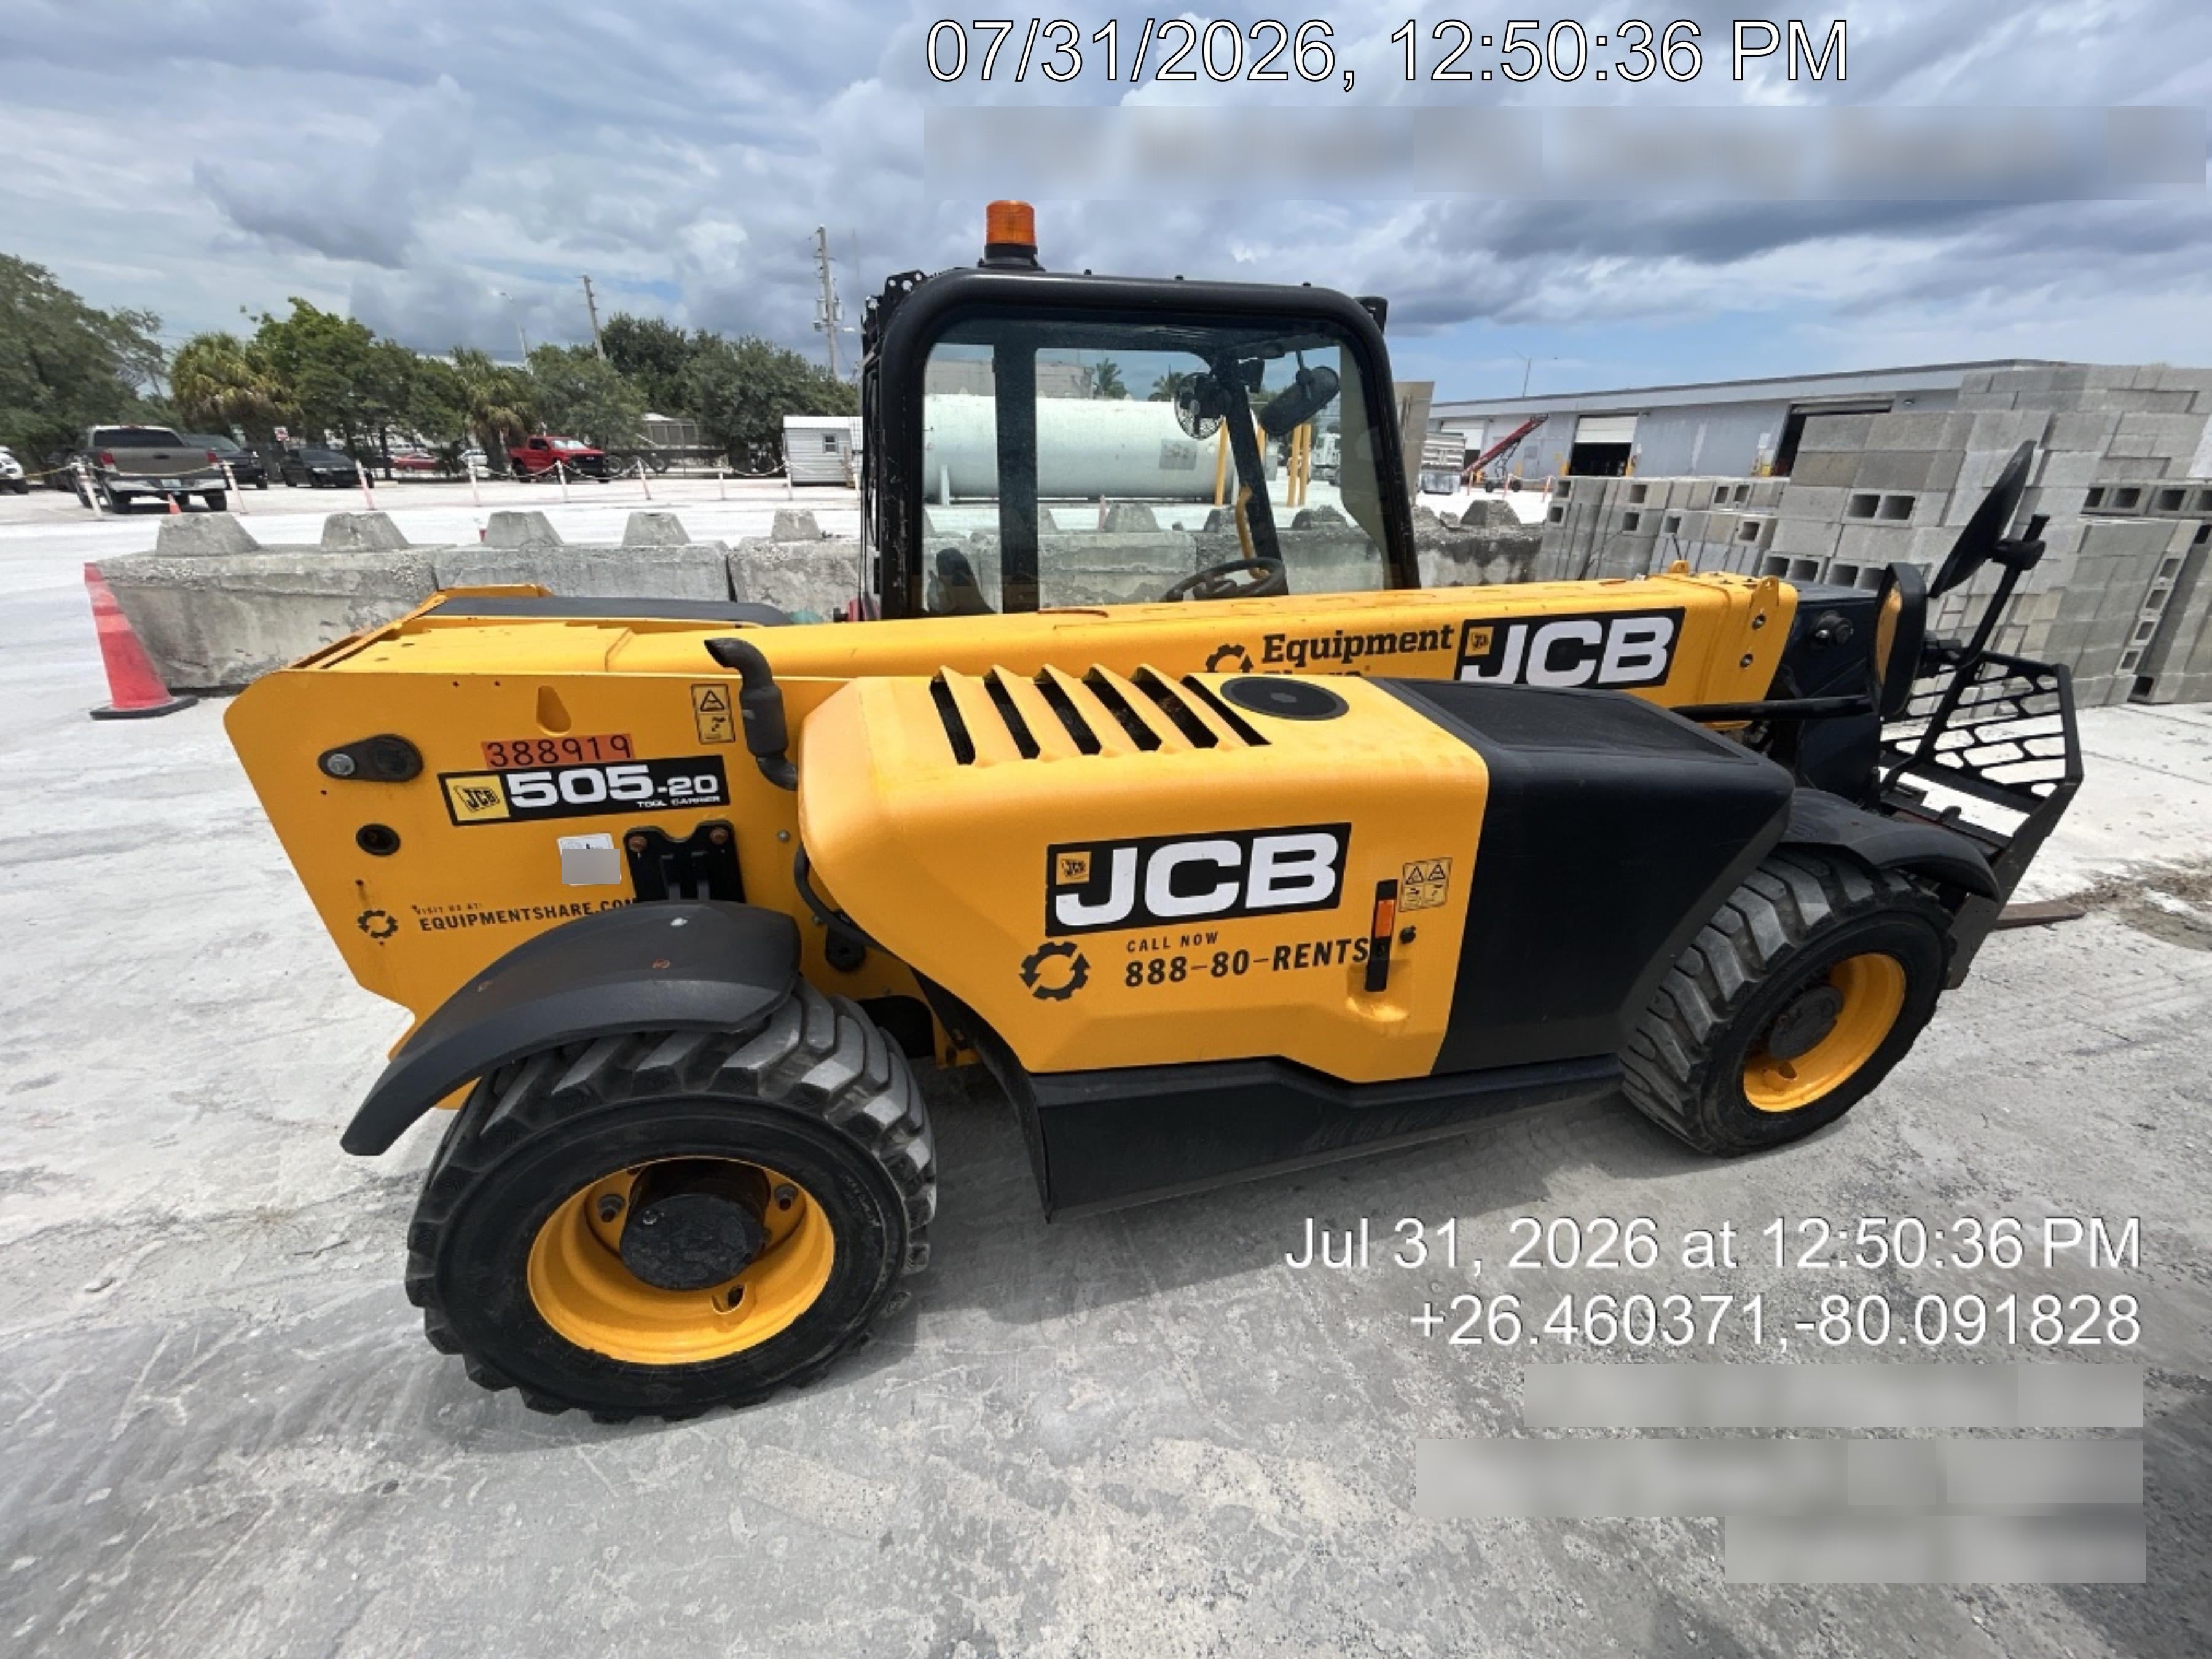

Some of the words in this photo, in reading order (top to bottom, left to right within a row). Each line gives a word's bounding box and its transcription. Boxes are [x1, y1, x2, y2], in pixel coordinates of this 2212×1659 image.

[1261, 624, 1455, 668] Equipment
[1459, 616, 1674, 687] JCB
[486, 735, 631, 767] 388919
[461, 786, 500, 809] JCB
[1055, 831, 1339, 927] JCB
[1125, 937, 1370, 987] 888-80-RENTS
[1126, 936, 1171, 953] CALL
[1180, 930, 1220, 947] NOW
